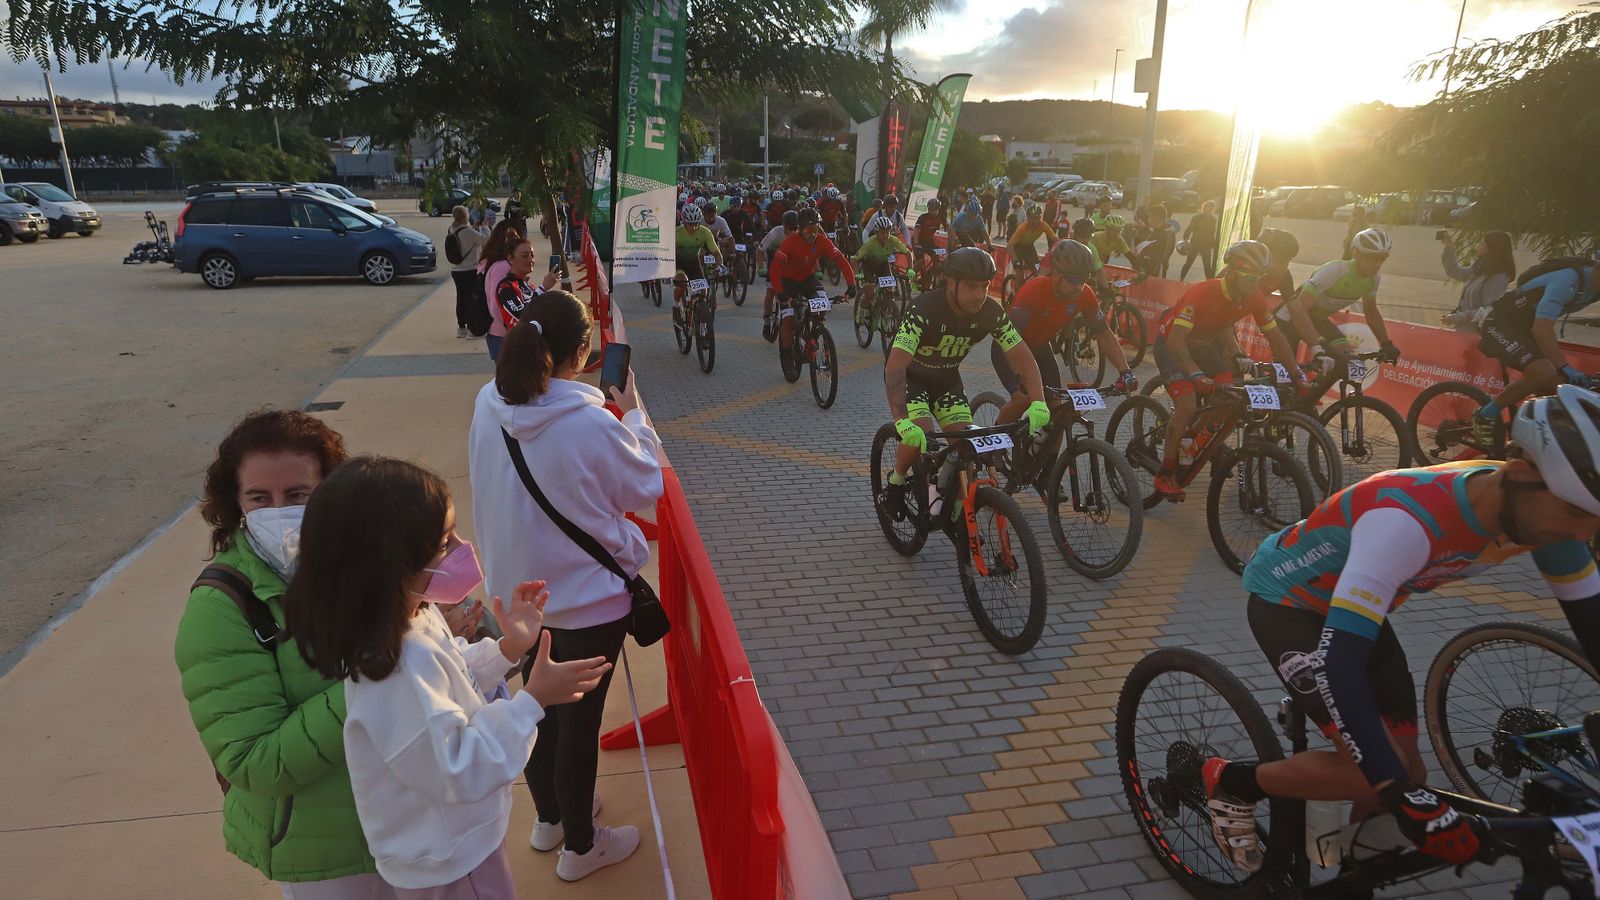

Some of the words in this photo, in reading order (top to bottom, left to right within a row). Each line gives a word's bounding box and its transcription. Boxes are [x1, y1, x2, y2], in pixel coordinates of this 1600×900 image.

[811, 302, 826, 310] 224
[1410, 360, 1472, 382] Ayuntamiento
[1473, 374, 1486, 386] de
[1074, 395, 1097, 406] 205
[1251, 393, 1273, 404] 238
[973, 435, 1003, 448] 303
